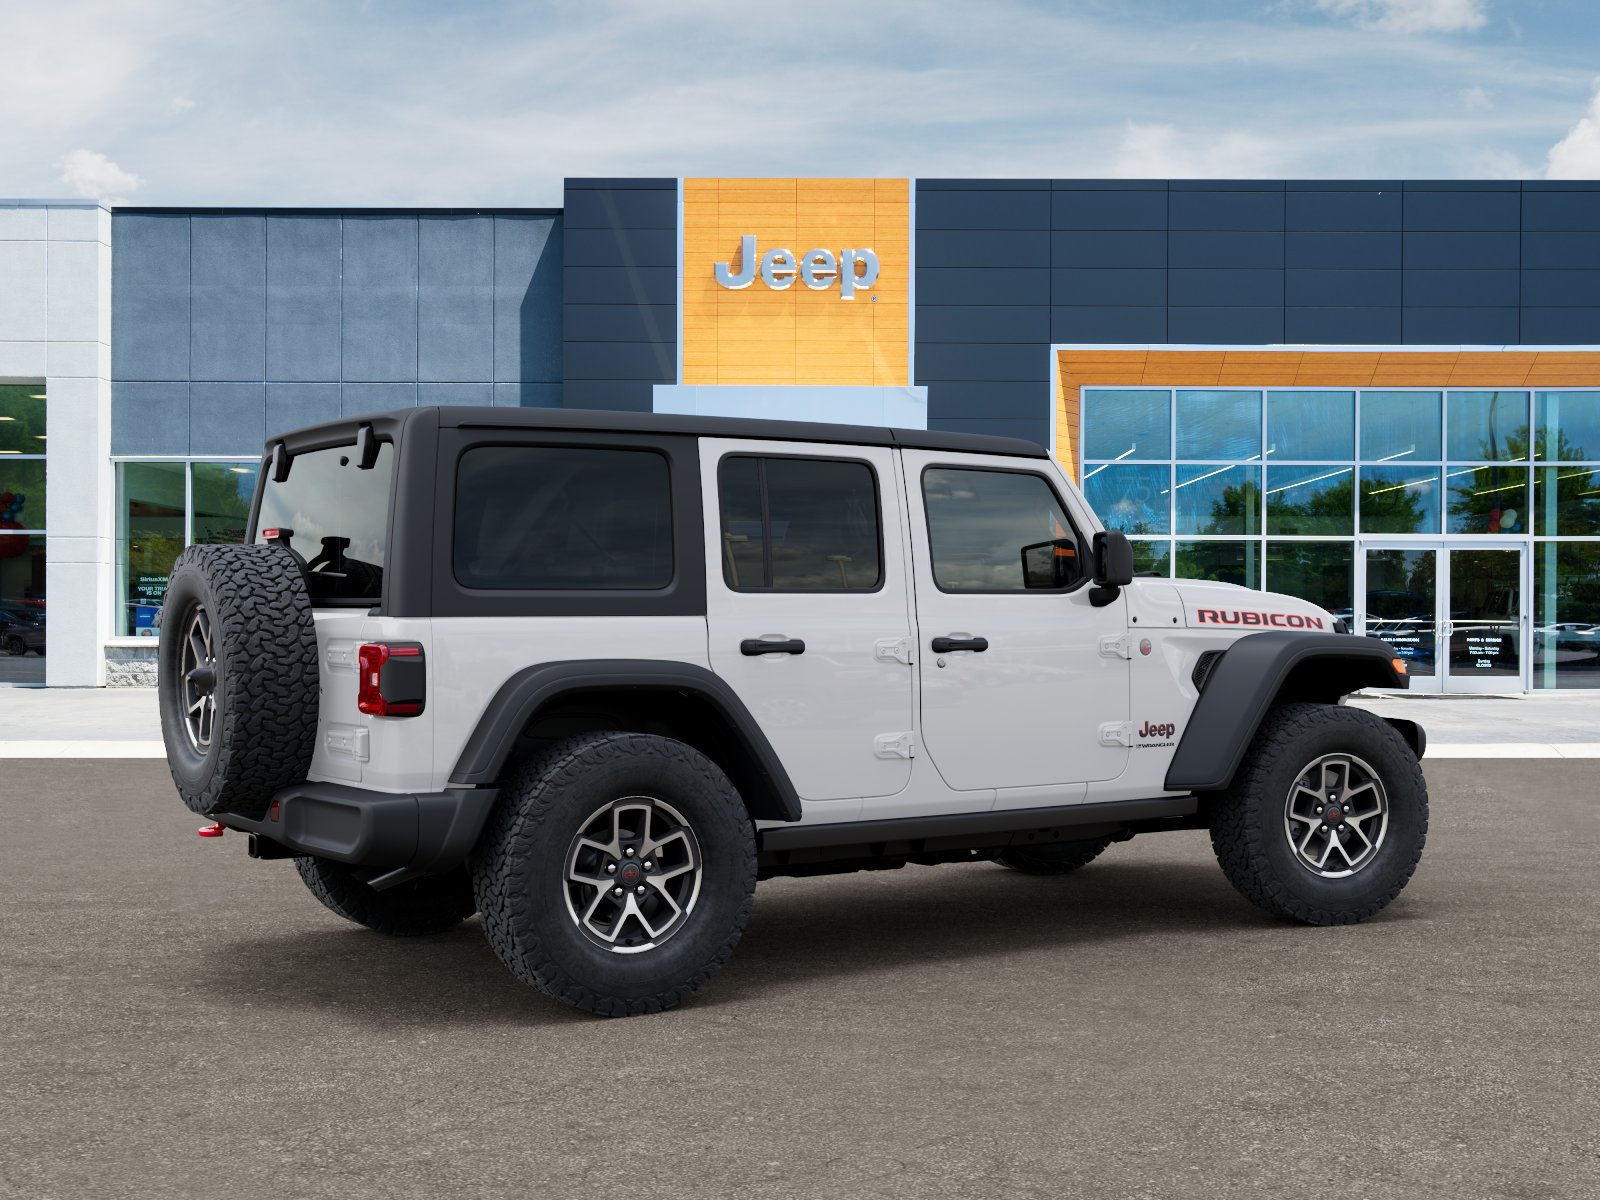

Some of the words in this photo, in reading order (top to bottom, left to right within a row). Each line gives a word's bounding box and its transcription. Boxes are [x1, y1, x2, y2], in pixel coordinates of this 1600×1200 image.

[714, 235, 880, 300] Jeep
[1198, 609, 1324, 630] RUBICON
[1138, 720, 1175, 739] Jeep
